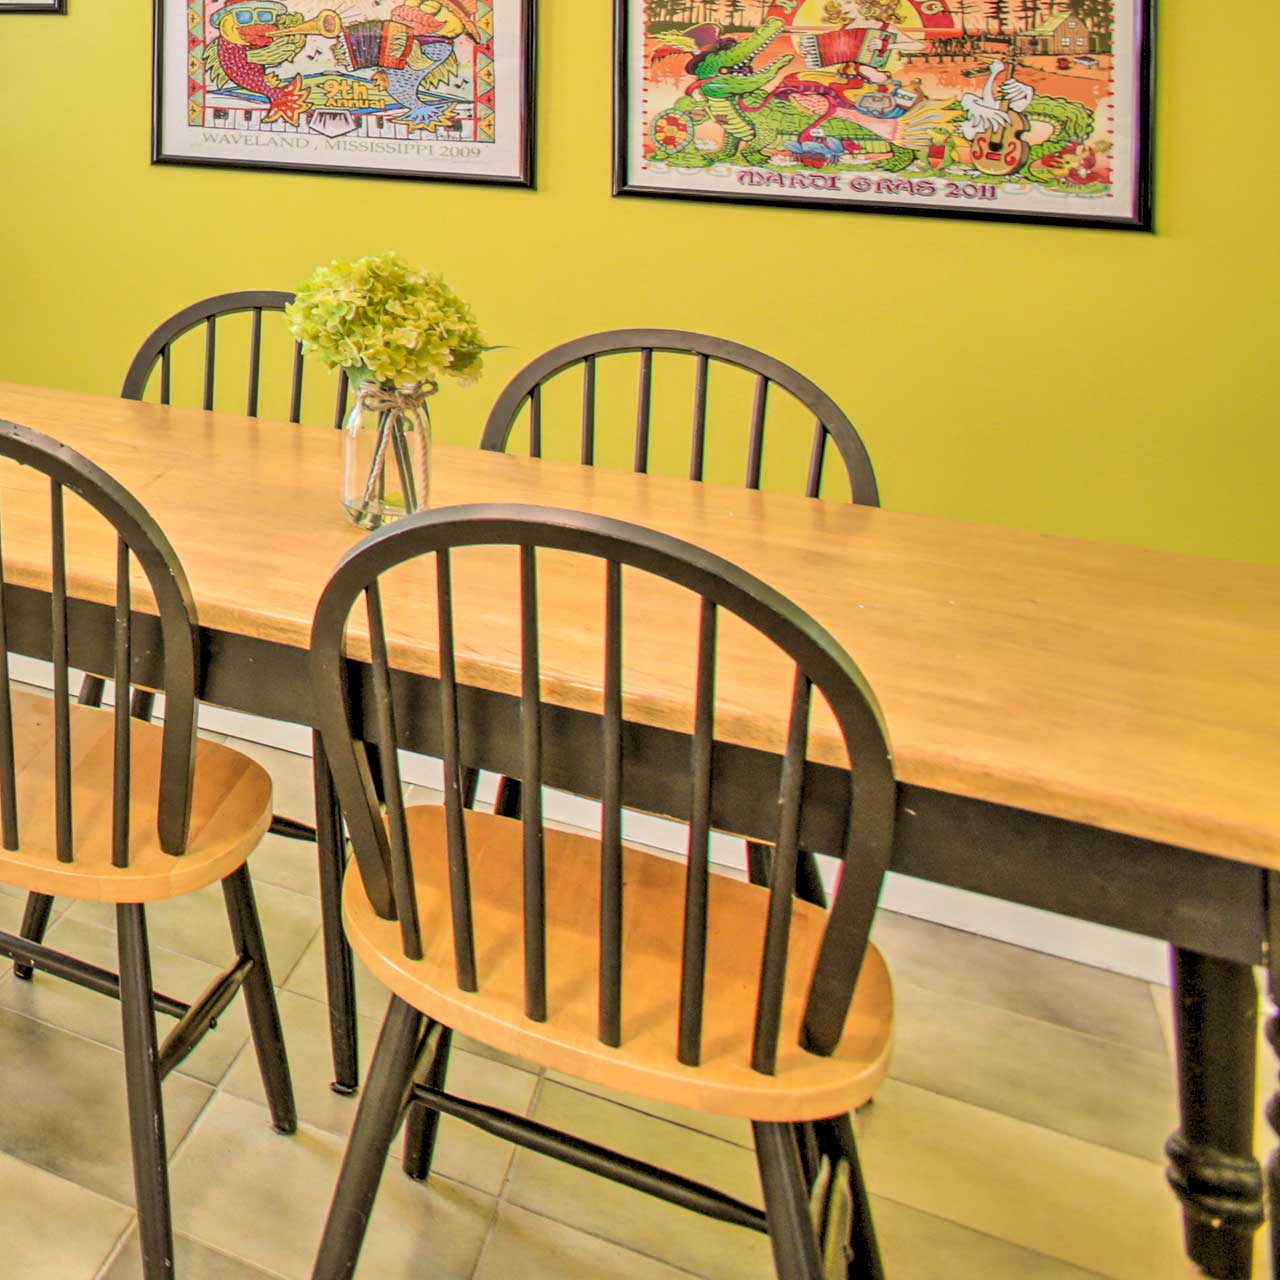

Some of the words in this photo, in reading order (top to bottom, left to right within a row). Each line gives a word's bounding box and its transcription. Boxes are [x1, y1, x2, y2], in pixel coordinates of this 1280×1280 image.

[323, 78, 369, 99] 9th
[202, 132, 310, 149] WAVELAND
[324, 139, 433, 157] MISSISSIPPI
[439, 146, 481, 159] 2009
[736, 169, 841, 191] MARDI
[849, 177, 936, 198] GRAS
[945, 181, 999, 200] 2011
